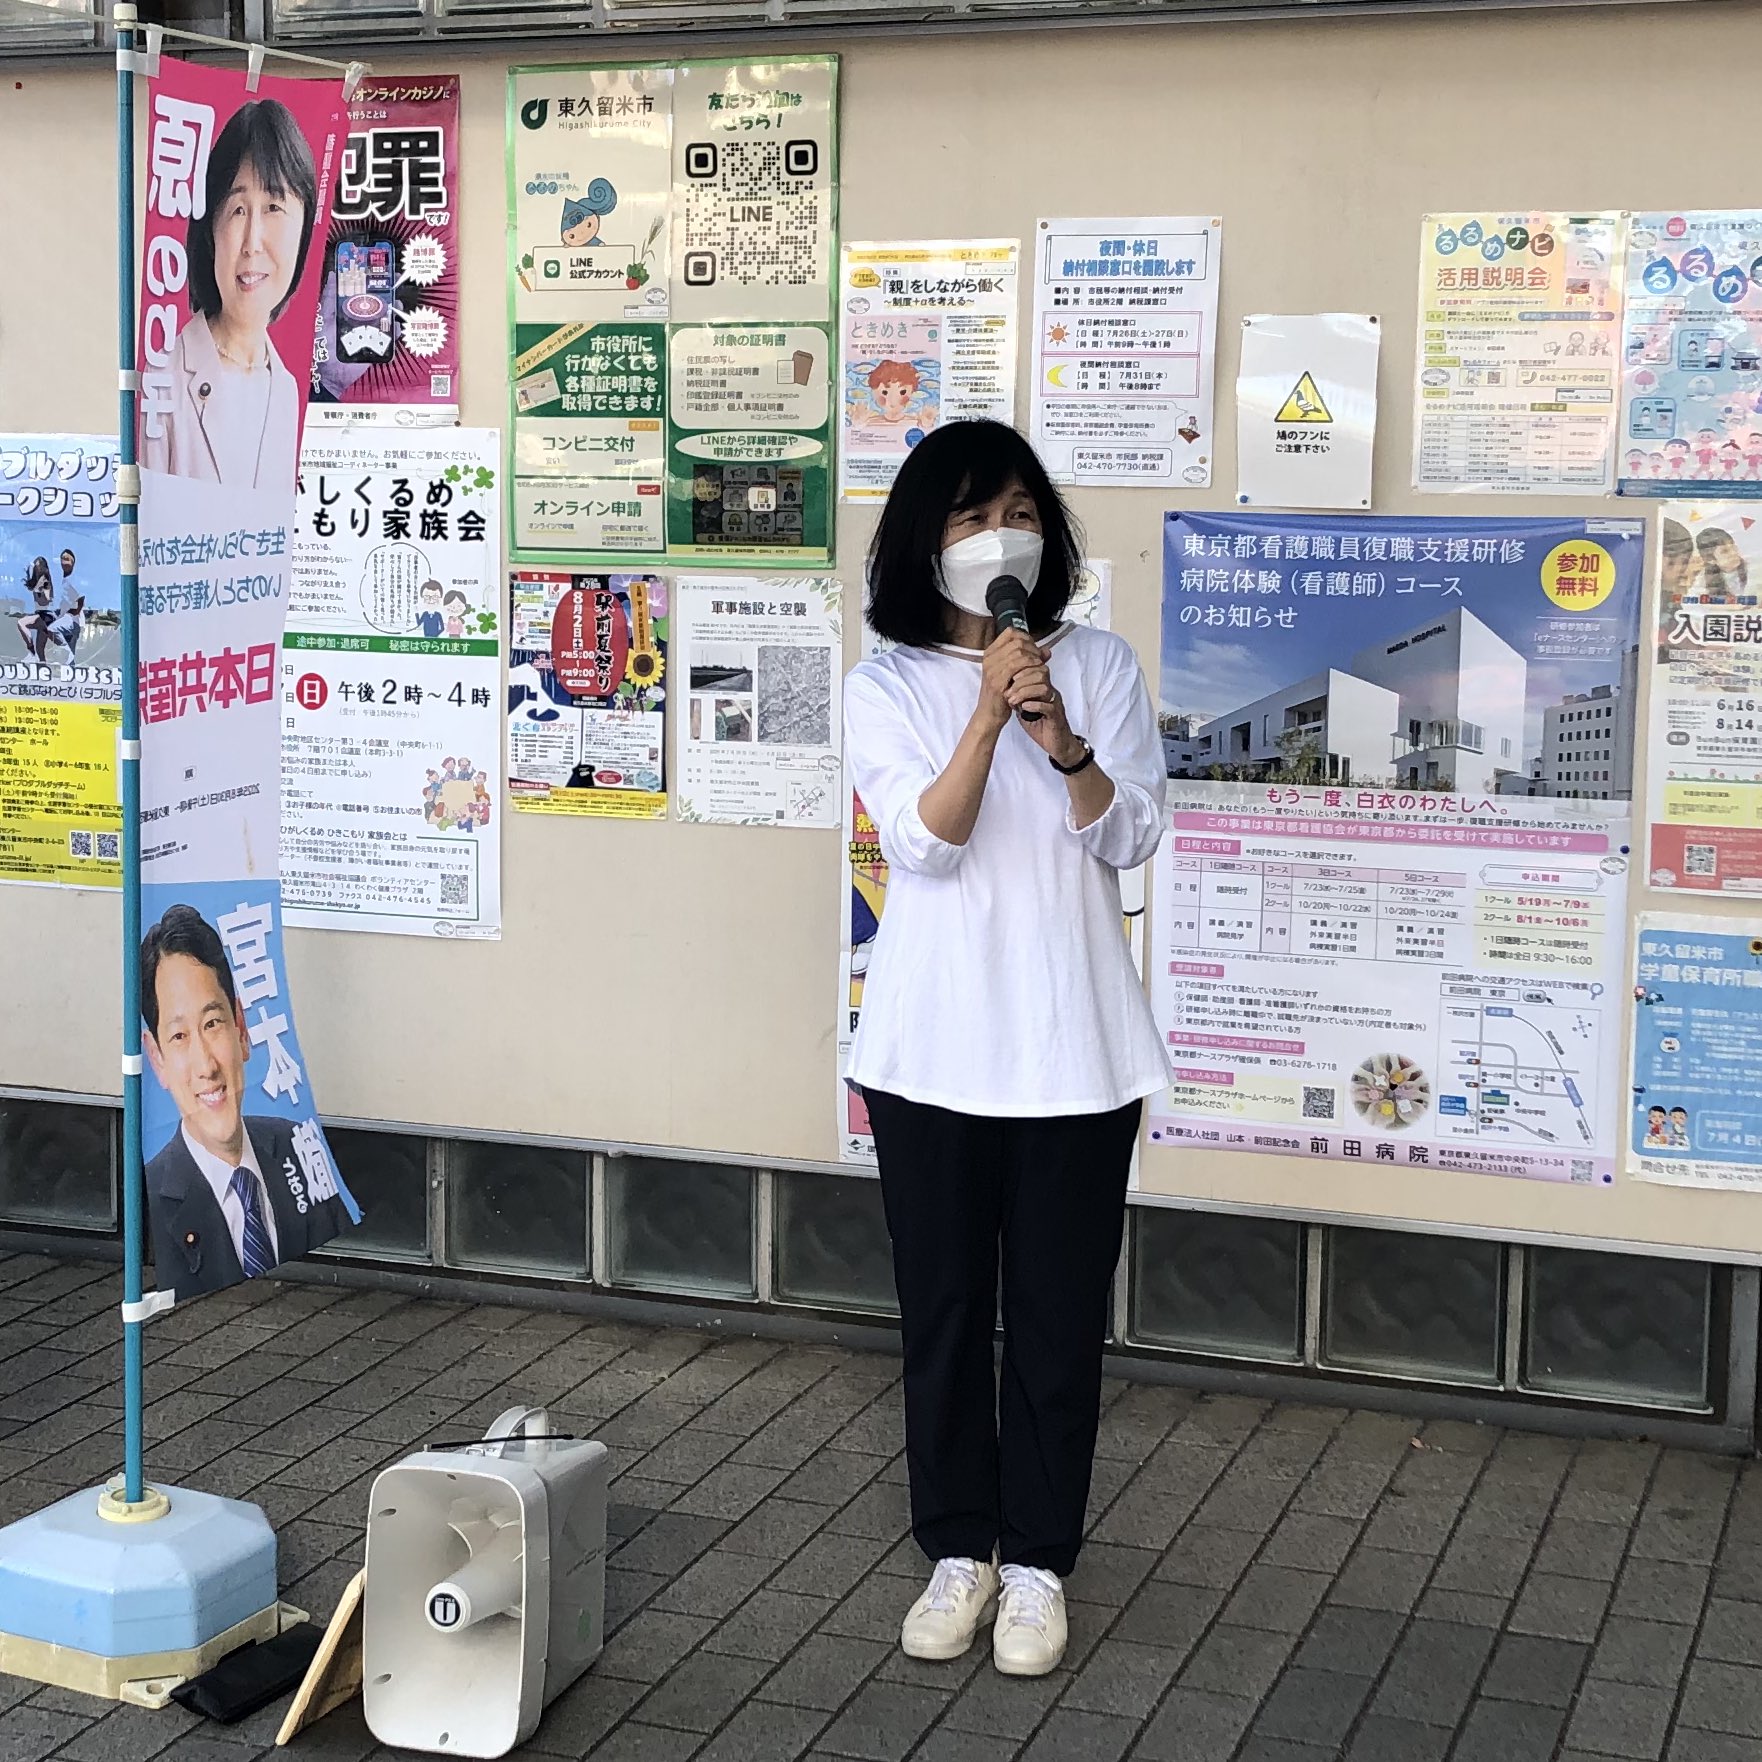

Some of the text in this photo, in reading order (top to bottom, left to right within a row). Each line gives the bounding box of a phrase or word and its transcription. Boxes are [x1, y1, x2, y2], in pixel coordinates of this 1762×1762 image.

[557, 94, 654, 118] 東久留米市
[558, 119, 652, 130] Higashikurume City
[729, 206, 773, 223] LINE
[1099, 239, 1159, 257] 夜間・休日
[1437, 224, 1552, 258] るるめナビ
[570, 257, 593, 268] LINE
[1062, 259, 1196, 277] 納付相談窓口を開設します
[569, 269, 624, 279] 公式アカウント
[1437, 266, 1550, 289] 活用説明会
[851, 321, 908, 339] ときめき
[591, 335, 653, 353] 市役所に
[713, 334, 787, 347] 対象の証明書
[565, 354, 658, 373] 行かなくても
[565, 375, 658, 393] 各種証明書を
[561, 393, 662, 412] 取得できます!
[543, 435, 635, 452] コンビニ交付
[701, 435, 799, 447] LINEから詳細確認や
[1276, 430, 1330, 441] 鳩のフンに
[713, 447, 784, 458] 申請ができます
[1275, 444, 1331, 454] ご注意下さい
[533, 500, 642, 518] オンライン申請
[293, 508, 487, 542] もり家族会
[1182, 533, 1526, 564] 東京都看護職員復職支援研修
[1557, 553, 1600, 574] 参加
[1555, 576, 1599, 597] 無料
[711, 600, 808, 617] 軍事施設と空襲
[1180, 603, 1298, 629] のお知らせ
[296, 635, 472, 653] 途中参加・退席可 秘密は守られます
[0, 663, 52, 682] uble
[337, 679, 492, 708] 午後2時〜4時
[1267, 787, 1508, 815] もう一度、白衣のわたしへ。
[1181, 840, 1231, 851] 日程と内容
[1175, 860, 1198, 868] コース
[1267, 866, 1289, 874] コース
[1404, 873, 1440, 883] 5日コース
[1642, 942, 1724, 961] 東久留米市
